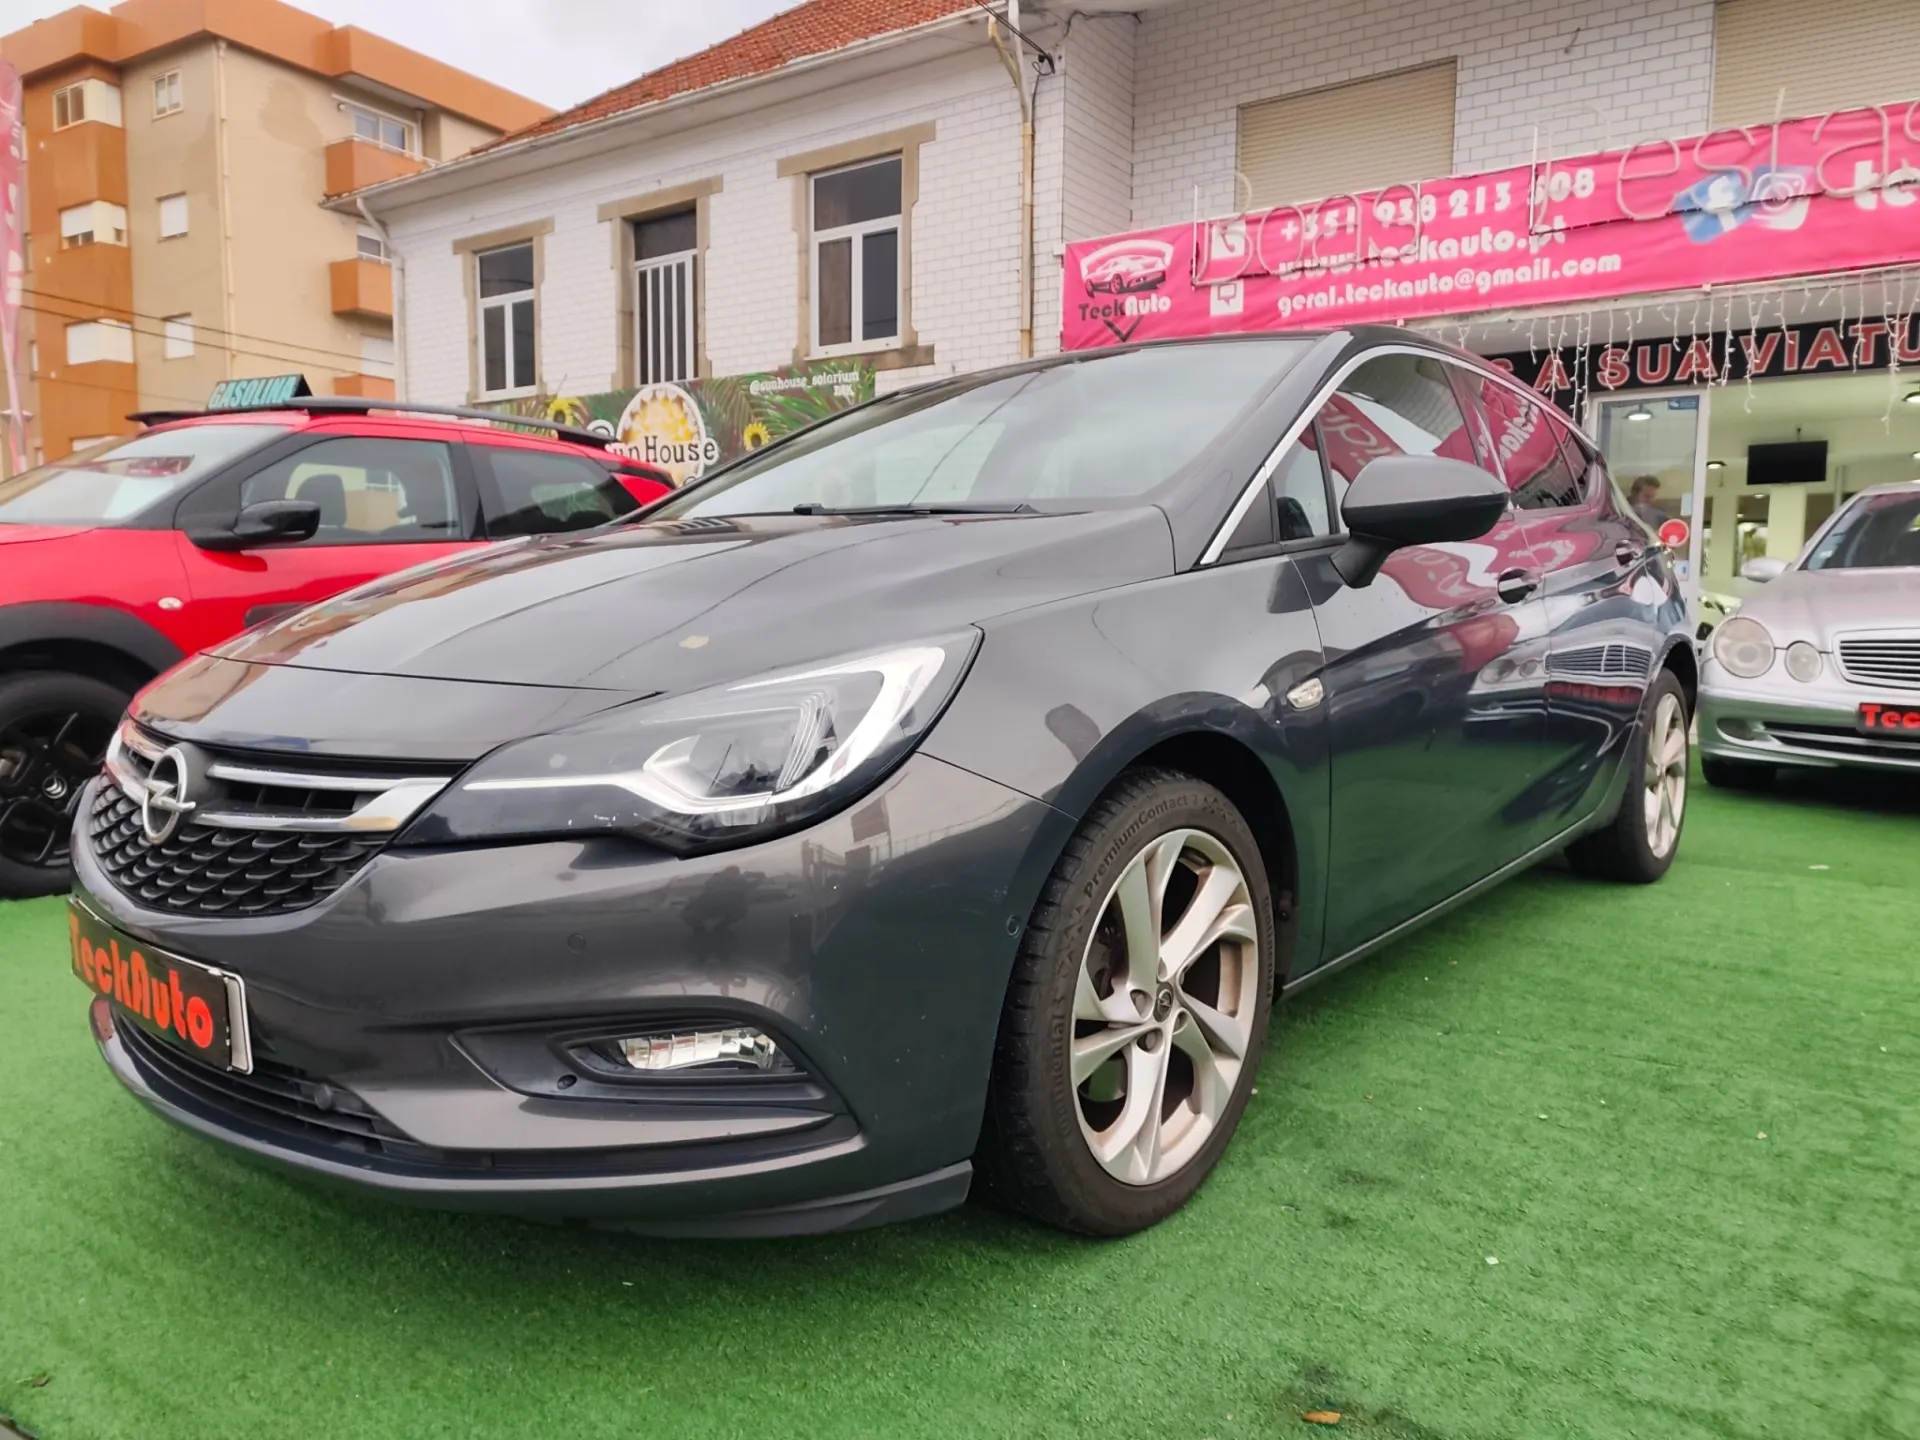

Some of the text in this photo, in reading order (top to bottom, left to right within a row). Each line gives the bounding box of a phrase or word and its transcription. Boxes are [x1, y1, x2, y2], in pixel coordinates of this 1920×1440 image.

[1448, 181, 1512, 218] 213
[1078, 292, 1172, 321] TeckAuto
[1277, 253, 1622, 318] geral.teckauto@gmail.com
[749, 370, 860, 396] @sunhouse_solarium
[1534, 354, 1571, 391] A
[1596, 340, 1718, 387] SUA
[207, 376, 298, 411] GASOLINA
[1083, 794, 1189, 898] PremiumContact
[68, 911, 214, 1049] TeckAuto
